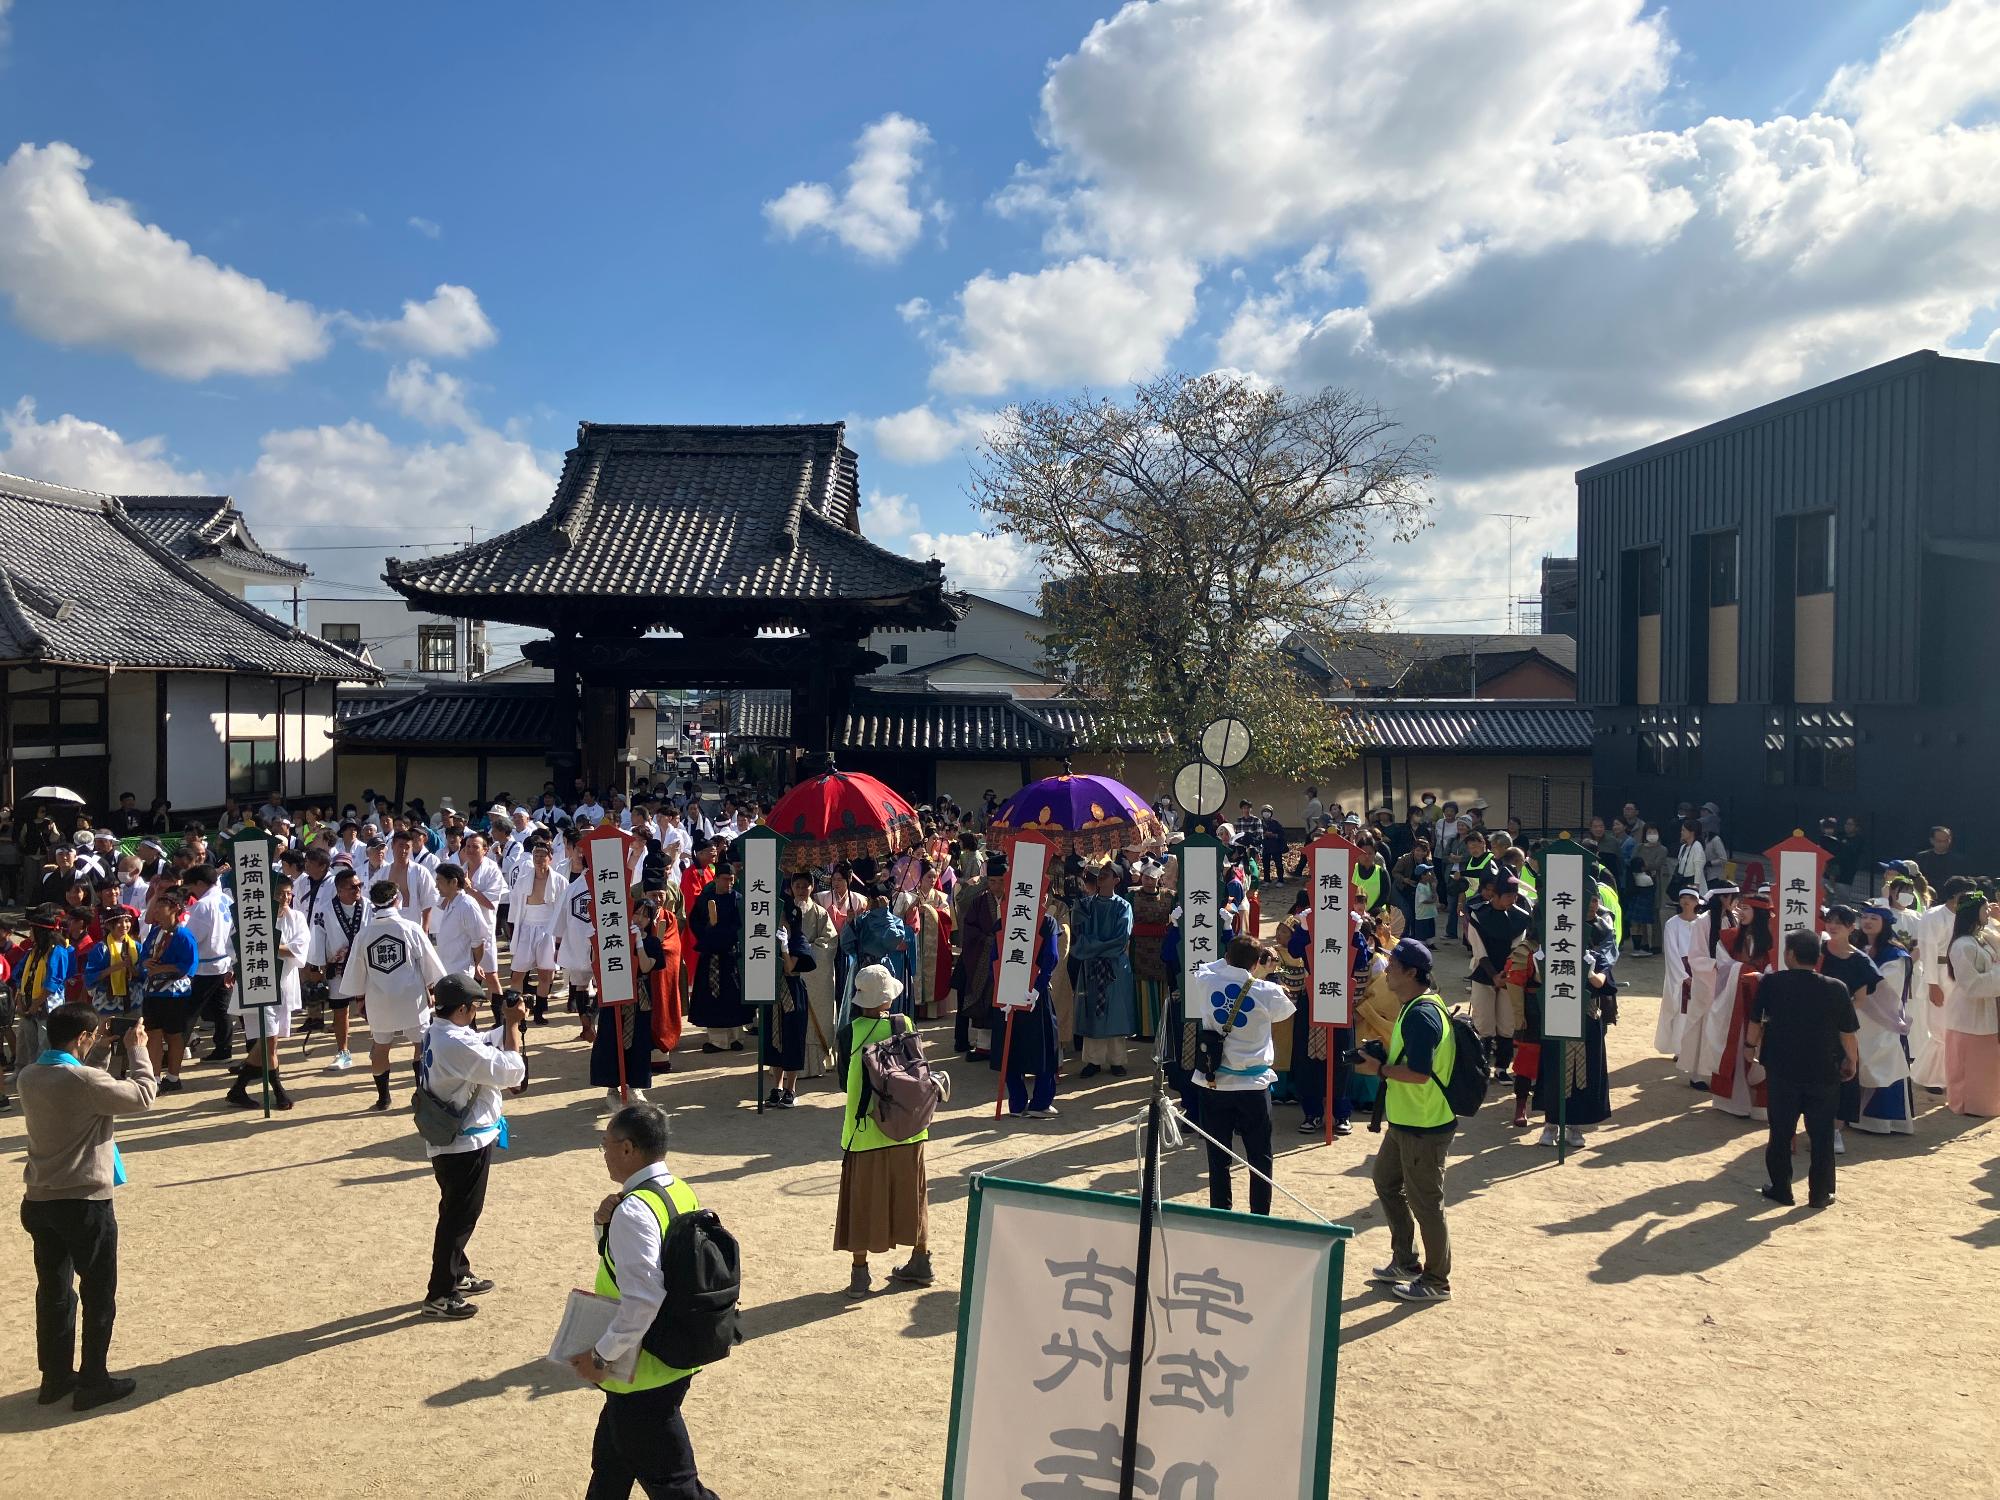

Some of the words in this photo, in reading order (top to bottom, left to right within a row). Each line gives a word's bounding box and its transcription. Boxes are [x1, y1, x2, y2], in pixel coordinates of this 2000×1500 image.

[598, 868, 624, 972] 和気清麻呂
[749, 879, 772, 960] 光明皇后
[1005, 882, 1035, 965] 聖武天皇
[1550, 891, 1577, 1000] 辛島女禰宜
